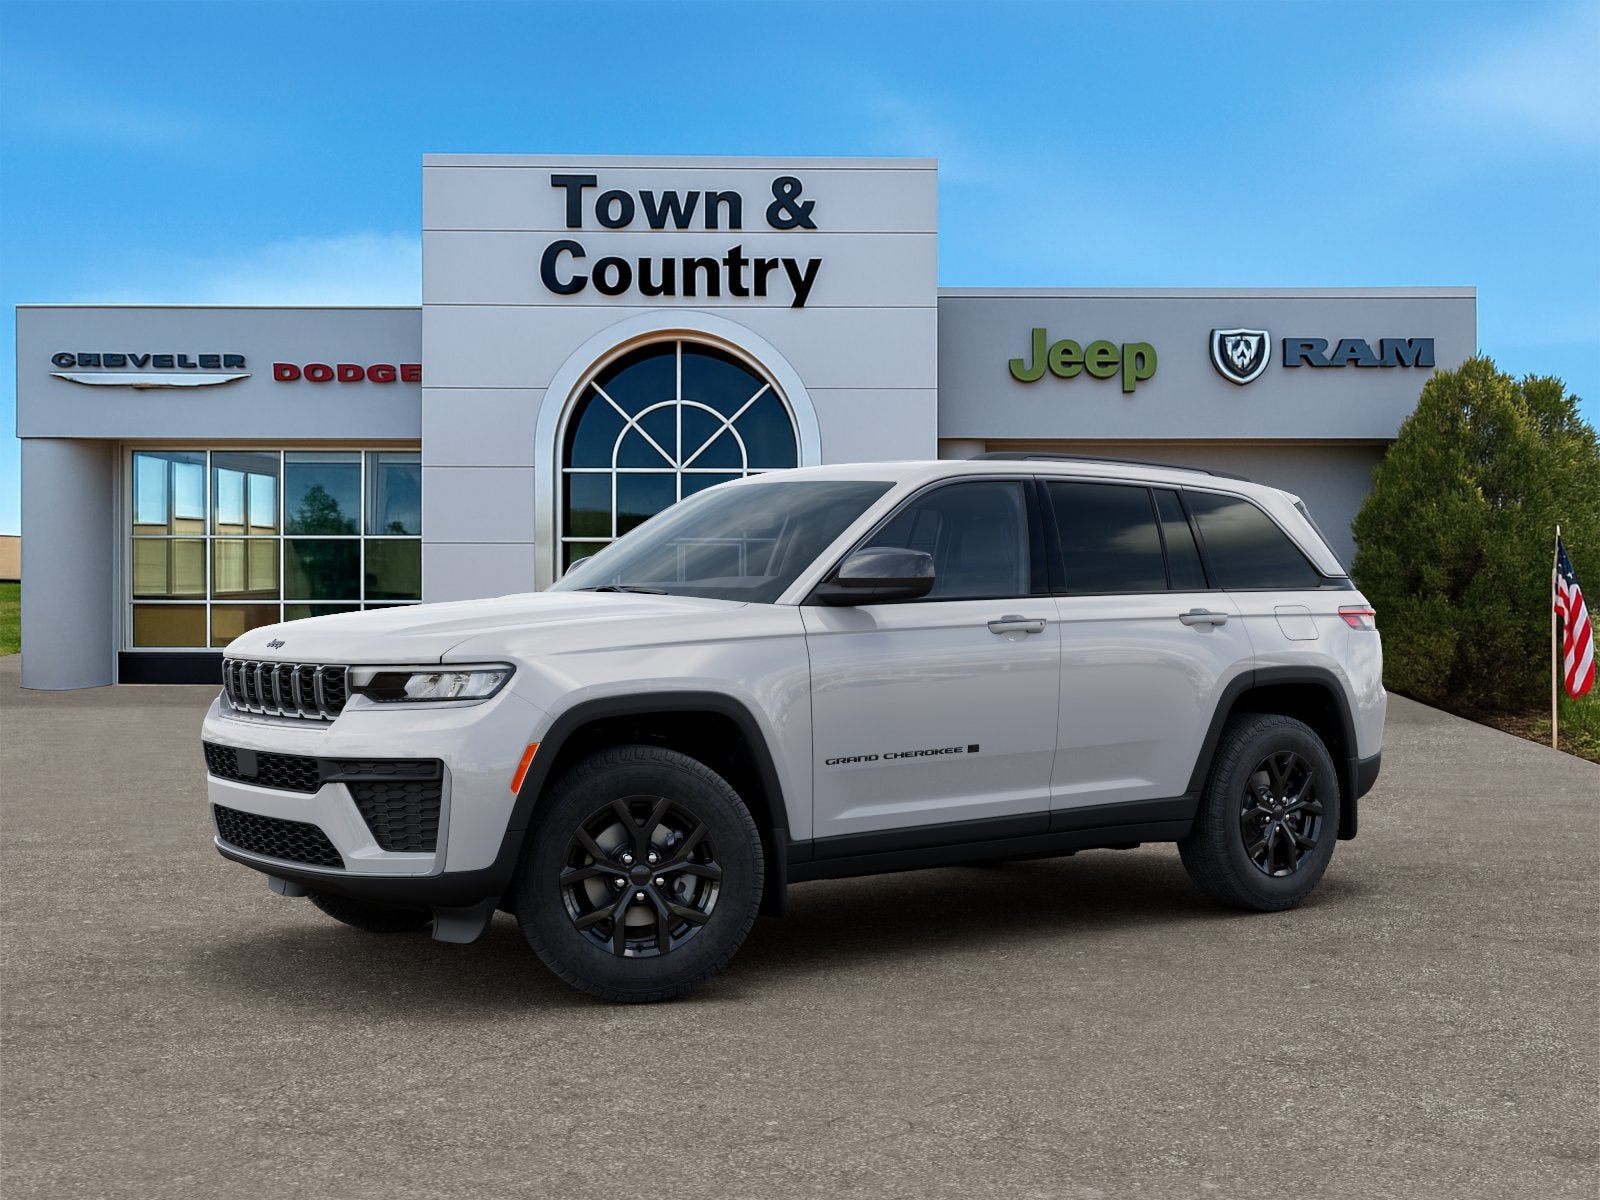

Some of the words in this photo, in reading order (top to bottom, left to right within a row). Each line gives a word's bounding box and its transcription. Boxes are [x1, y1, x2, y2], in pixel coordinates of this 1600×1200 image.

[551, 174, 743, 229] Town
[766, 176, 818, 230] &
[540, 240, 822, 308] Country
[273, 363, 422, 383] DODGE
[1009, 327, 1157, 393] Jeep
[1283, 337, 1435, 368] RAM
[825, 754, 879, 766] GRAND
[883, 746, 964, 760] CHEROKEE
